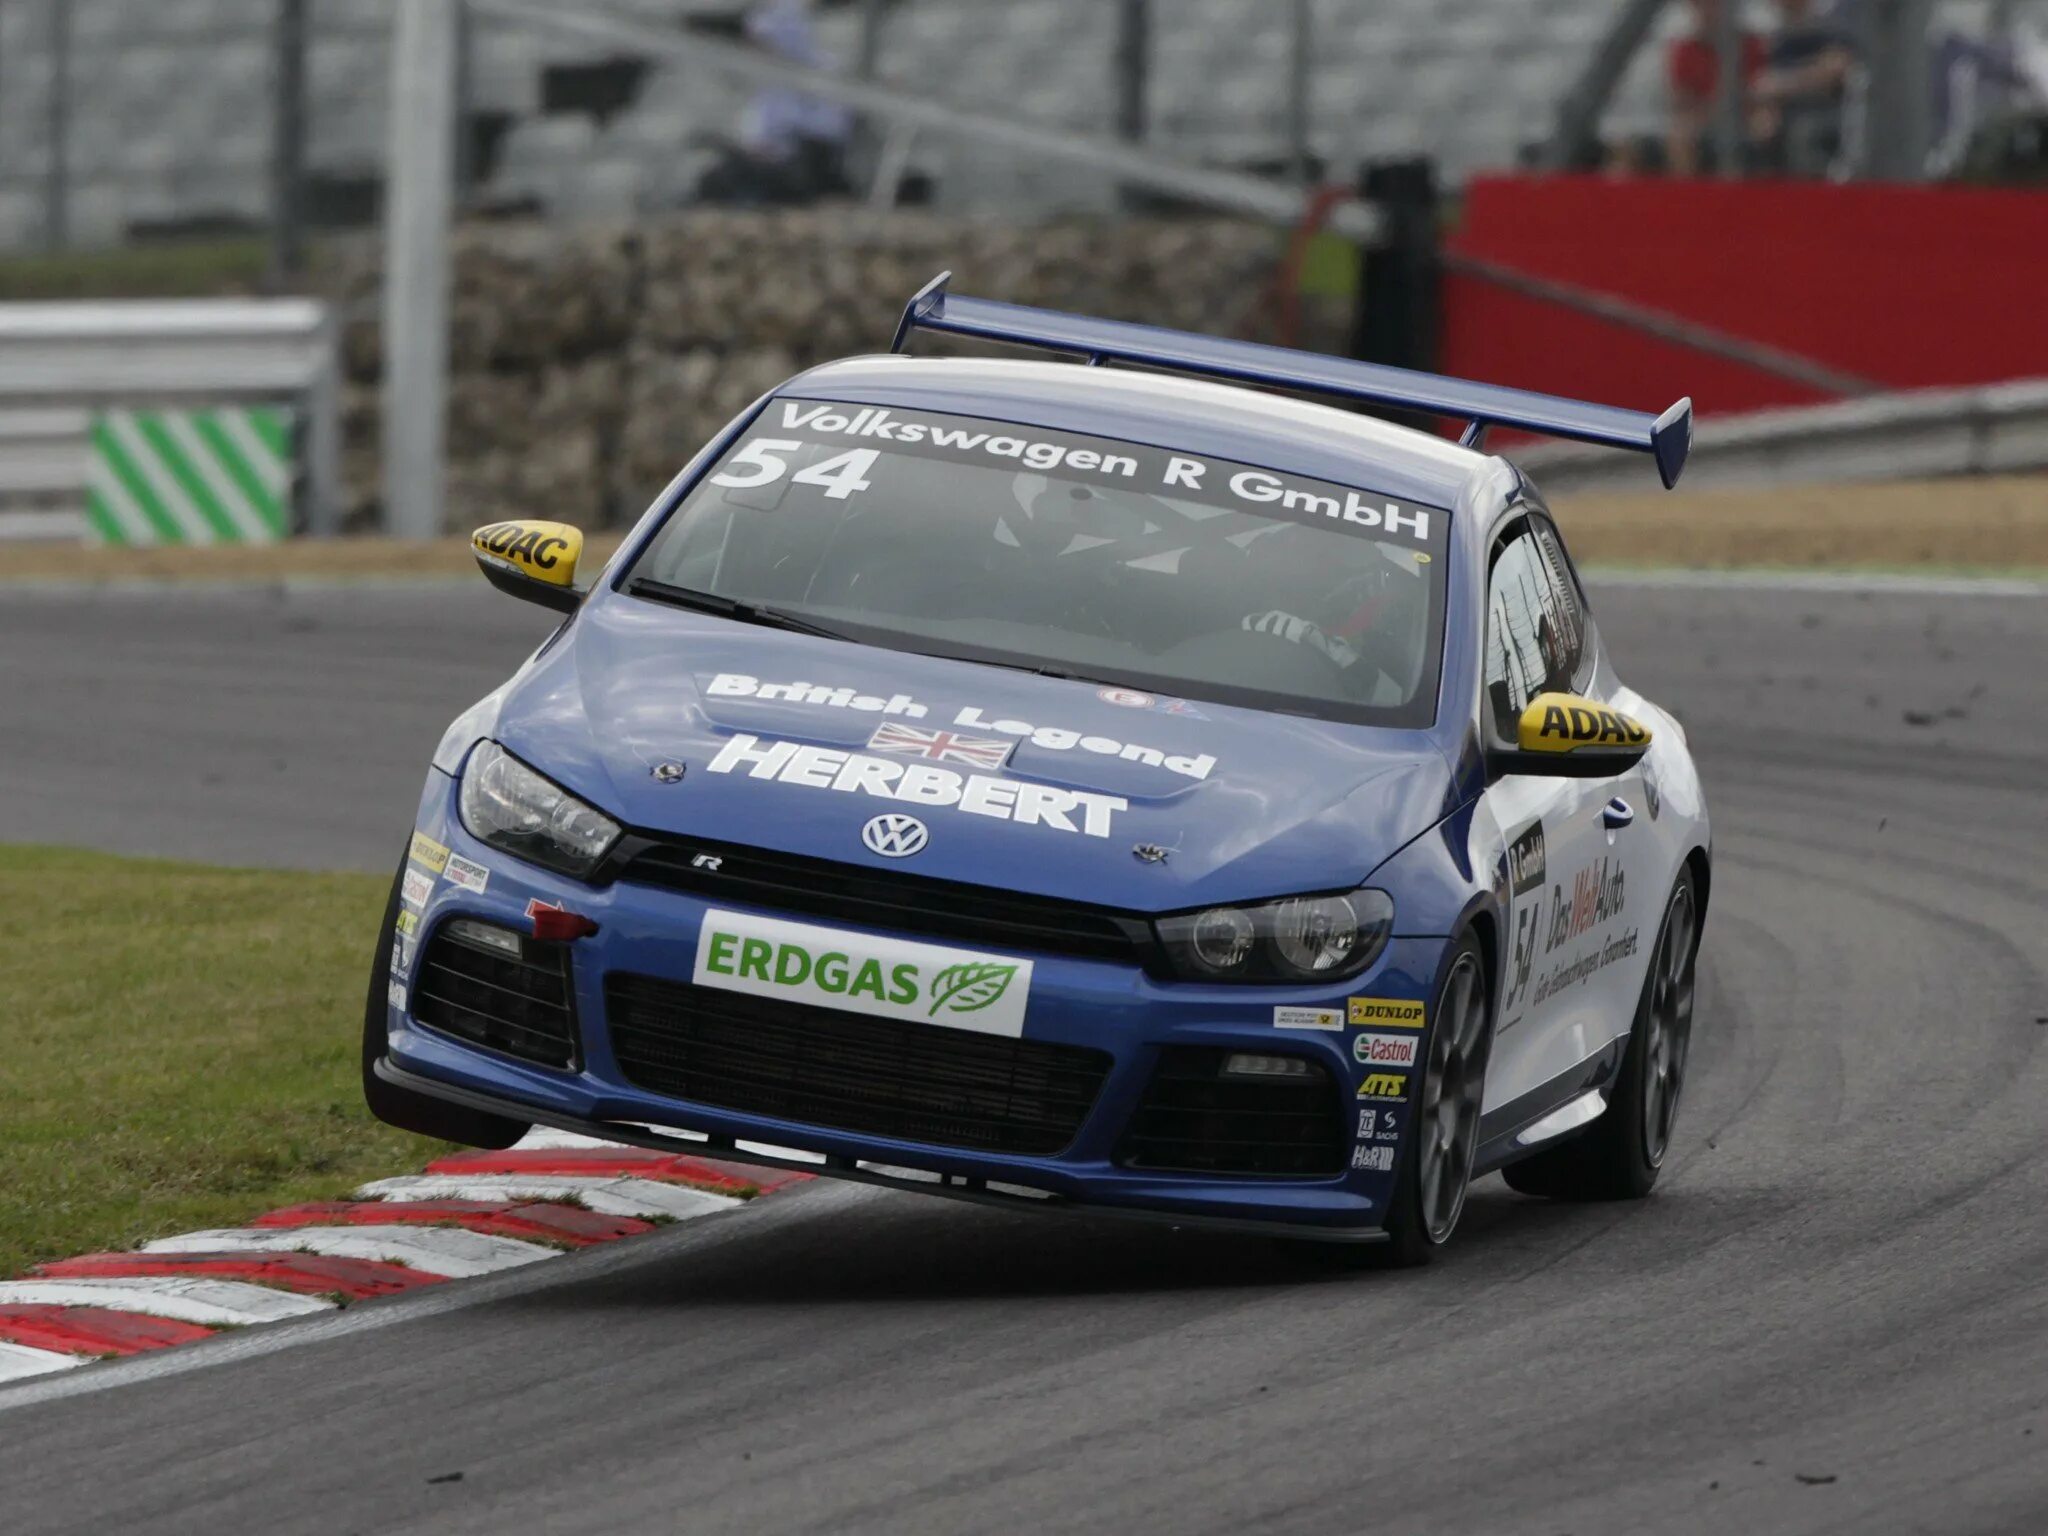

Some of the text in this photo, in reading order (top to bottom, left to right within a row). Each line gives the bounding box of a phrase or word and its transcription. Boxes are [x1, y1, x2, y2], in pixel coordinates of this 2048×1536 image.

[709, 437, 882, 500] 54
[782, 402, 1430, 541] Volkswagen R GmbH
[475, 524, 569, 569] ADAC
[706, 673, 1218, 781] British Legend
[1540, 705, 1646, 743] ADAC
[705, 733, 1129, 839] HERBERT
[691, 853, 723, 871] R
[706, 931, 920, 1006] ERDGAS
[1506, 902, 1540, 1011] 54
[1363, 1005, 1423, 1020] DUNLOP
[1371, 1038, 1414, 1062] Castrol
[1357, 1073, 1407, 1096] ATS
[1351, 1144, 1381, 1170] H&R
